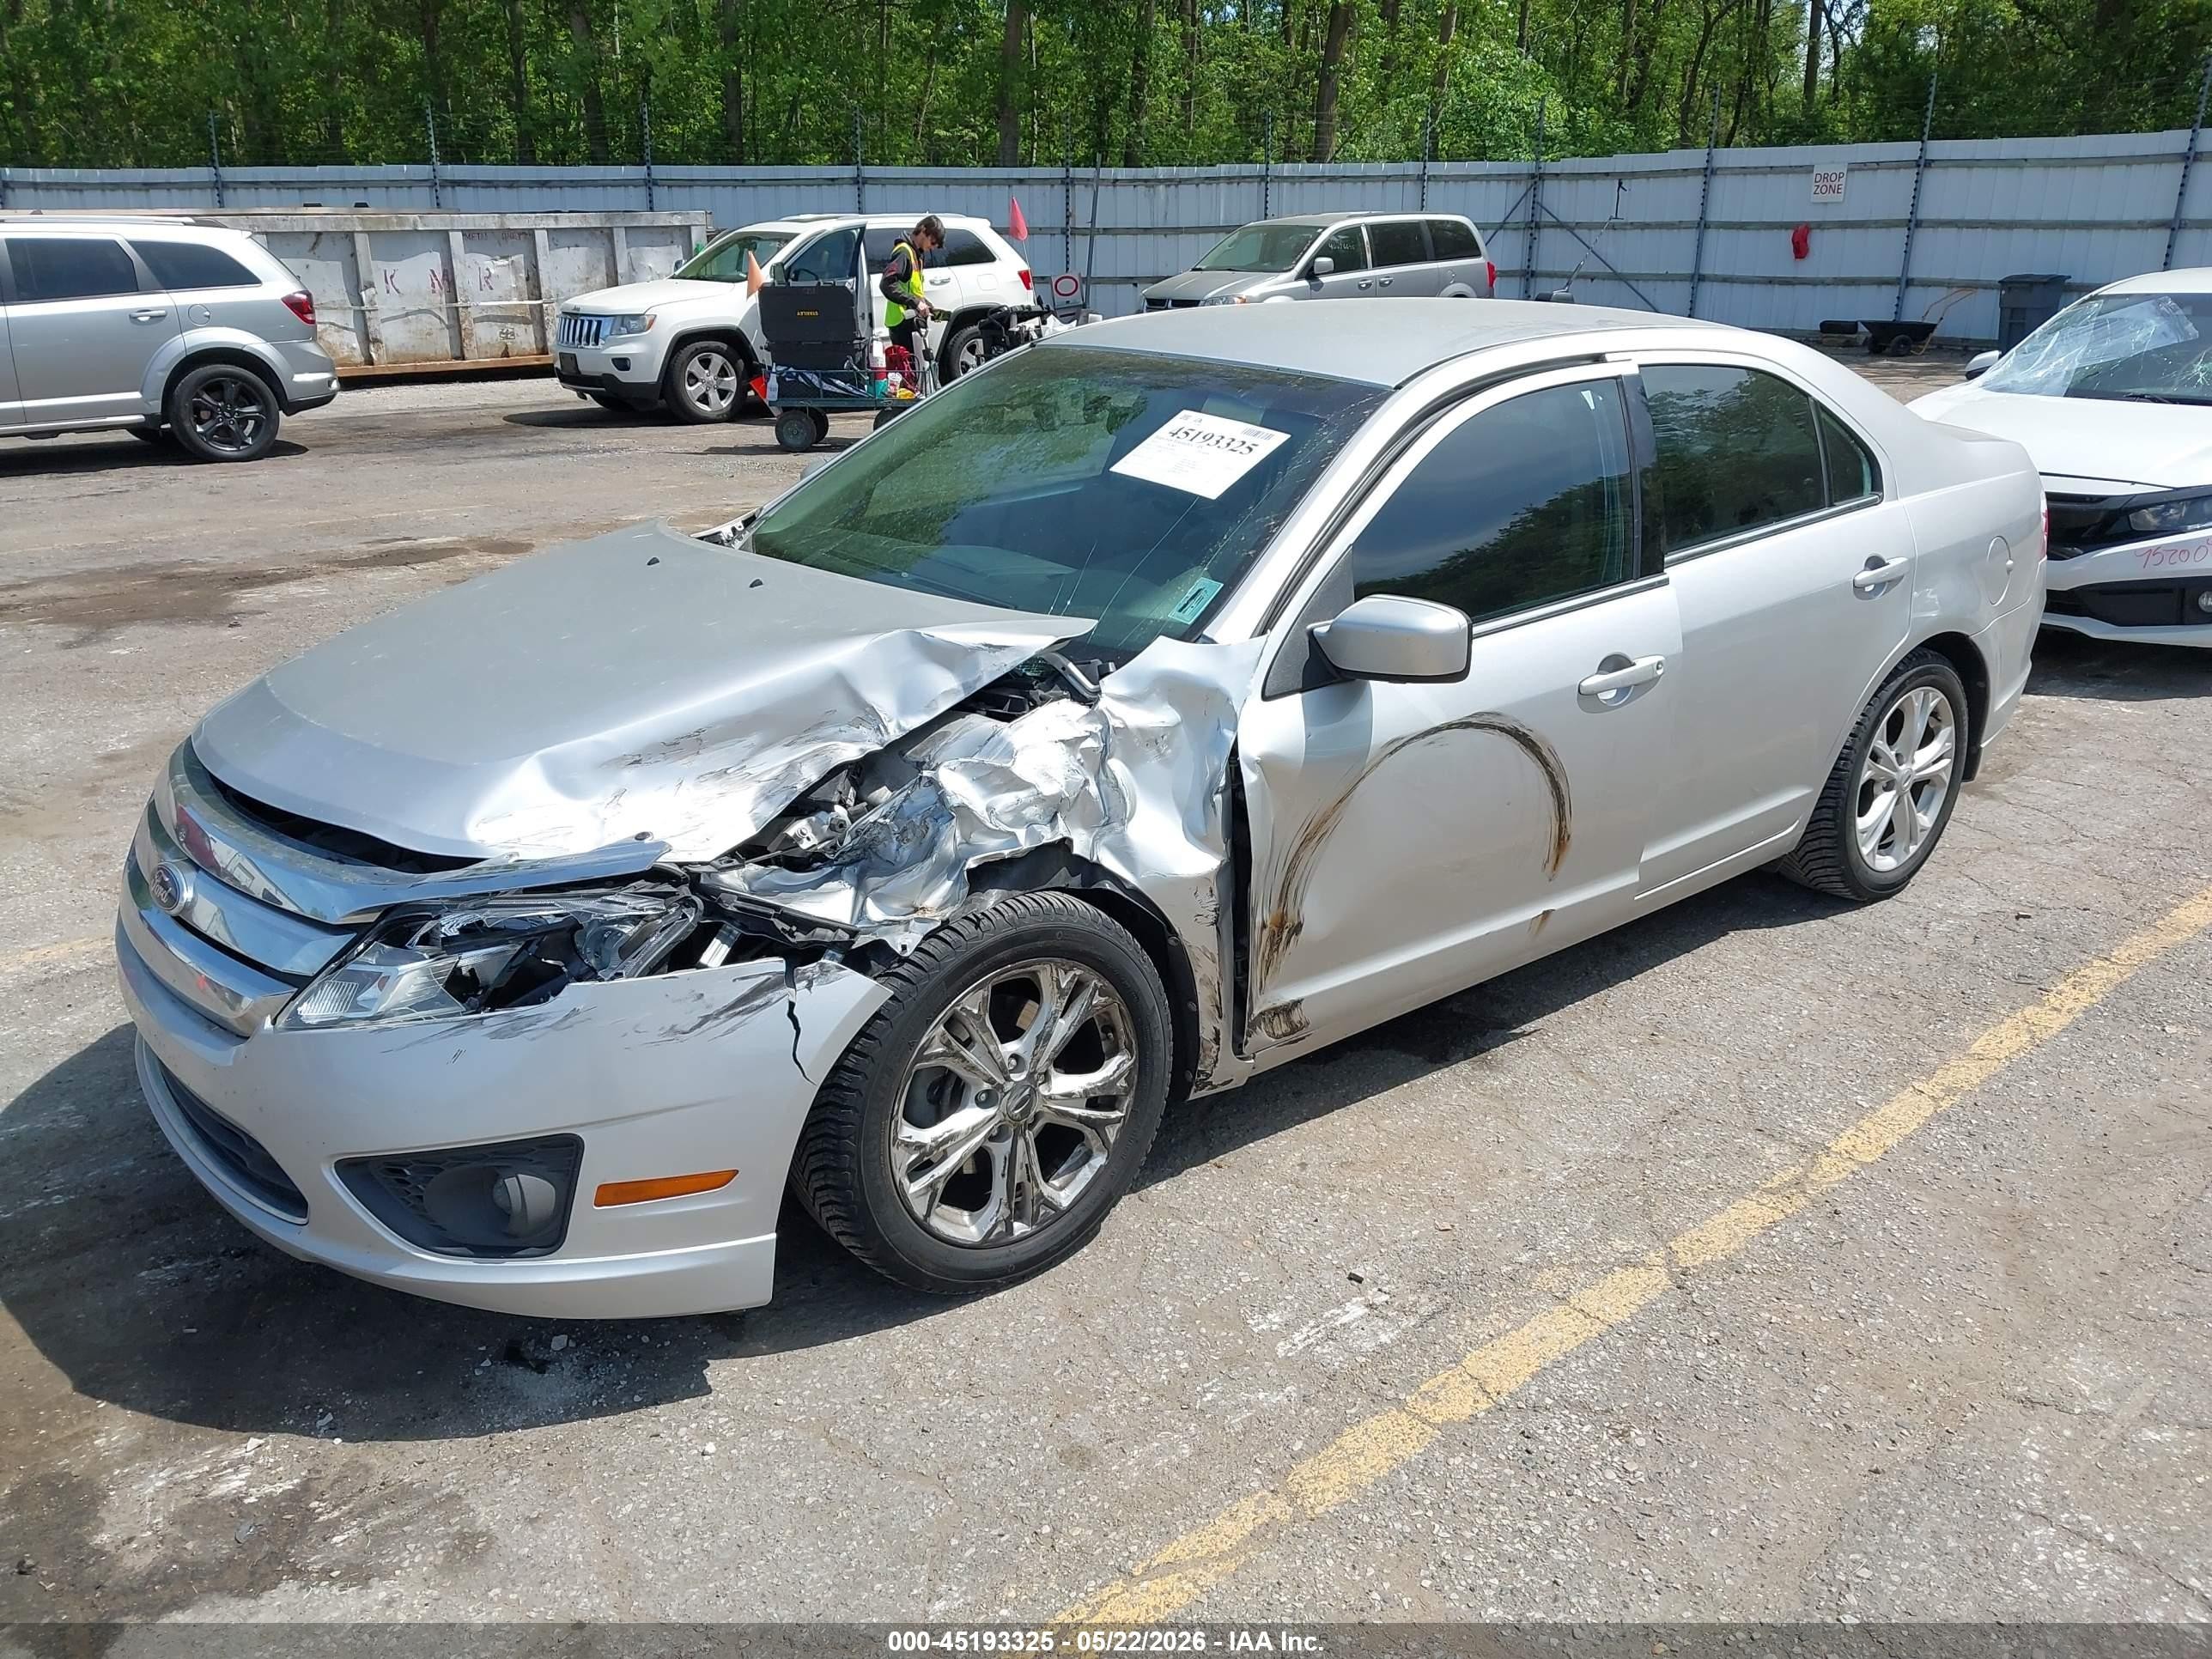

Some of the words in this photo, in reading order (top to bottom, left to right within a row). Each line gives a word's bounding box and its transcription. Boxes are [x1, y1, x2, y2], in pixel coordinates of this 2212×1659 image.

[1814, 172, 1845, 183] DROP
[1814, 184, 1844, 195] ZONE
[384, 268, 402, 295] K
[478, 266, 495, 292] R
[1169, 426, 1259, 455] 45193325
